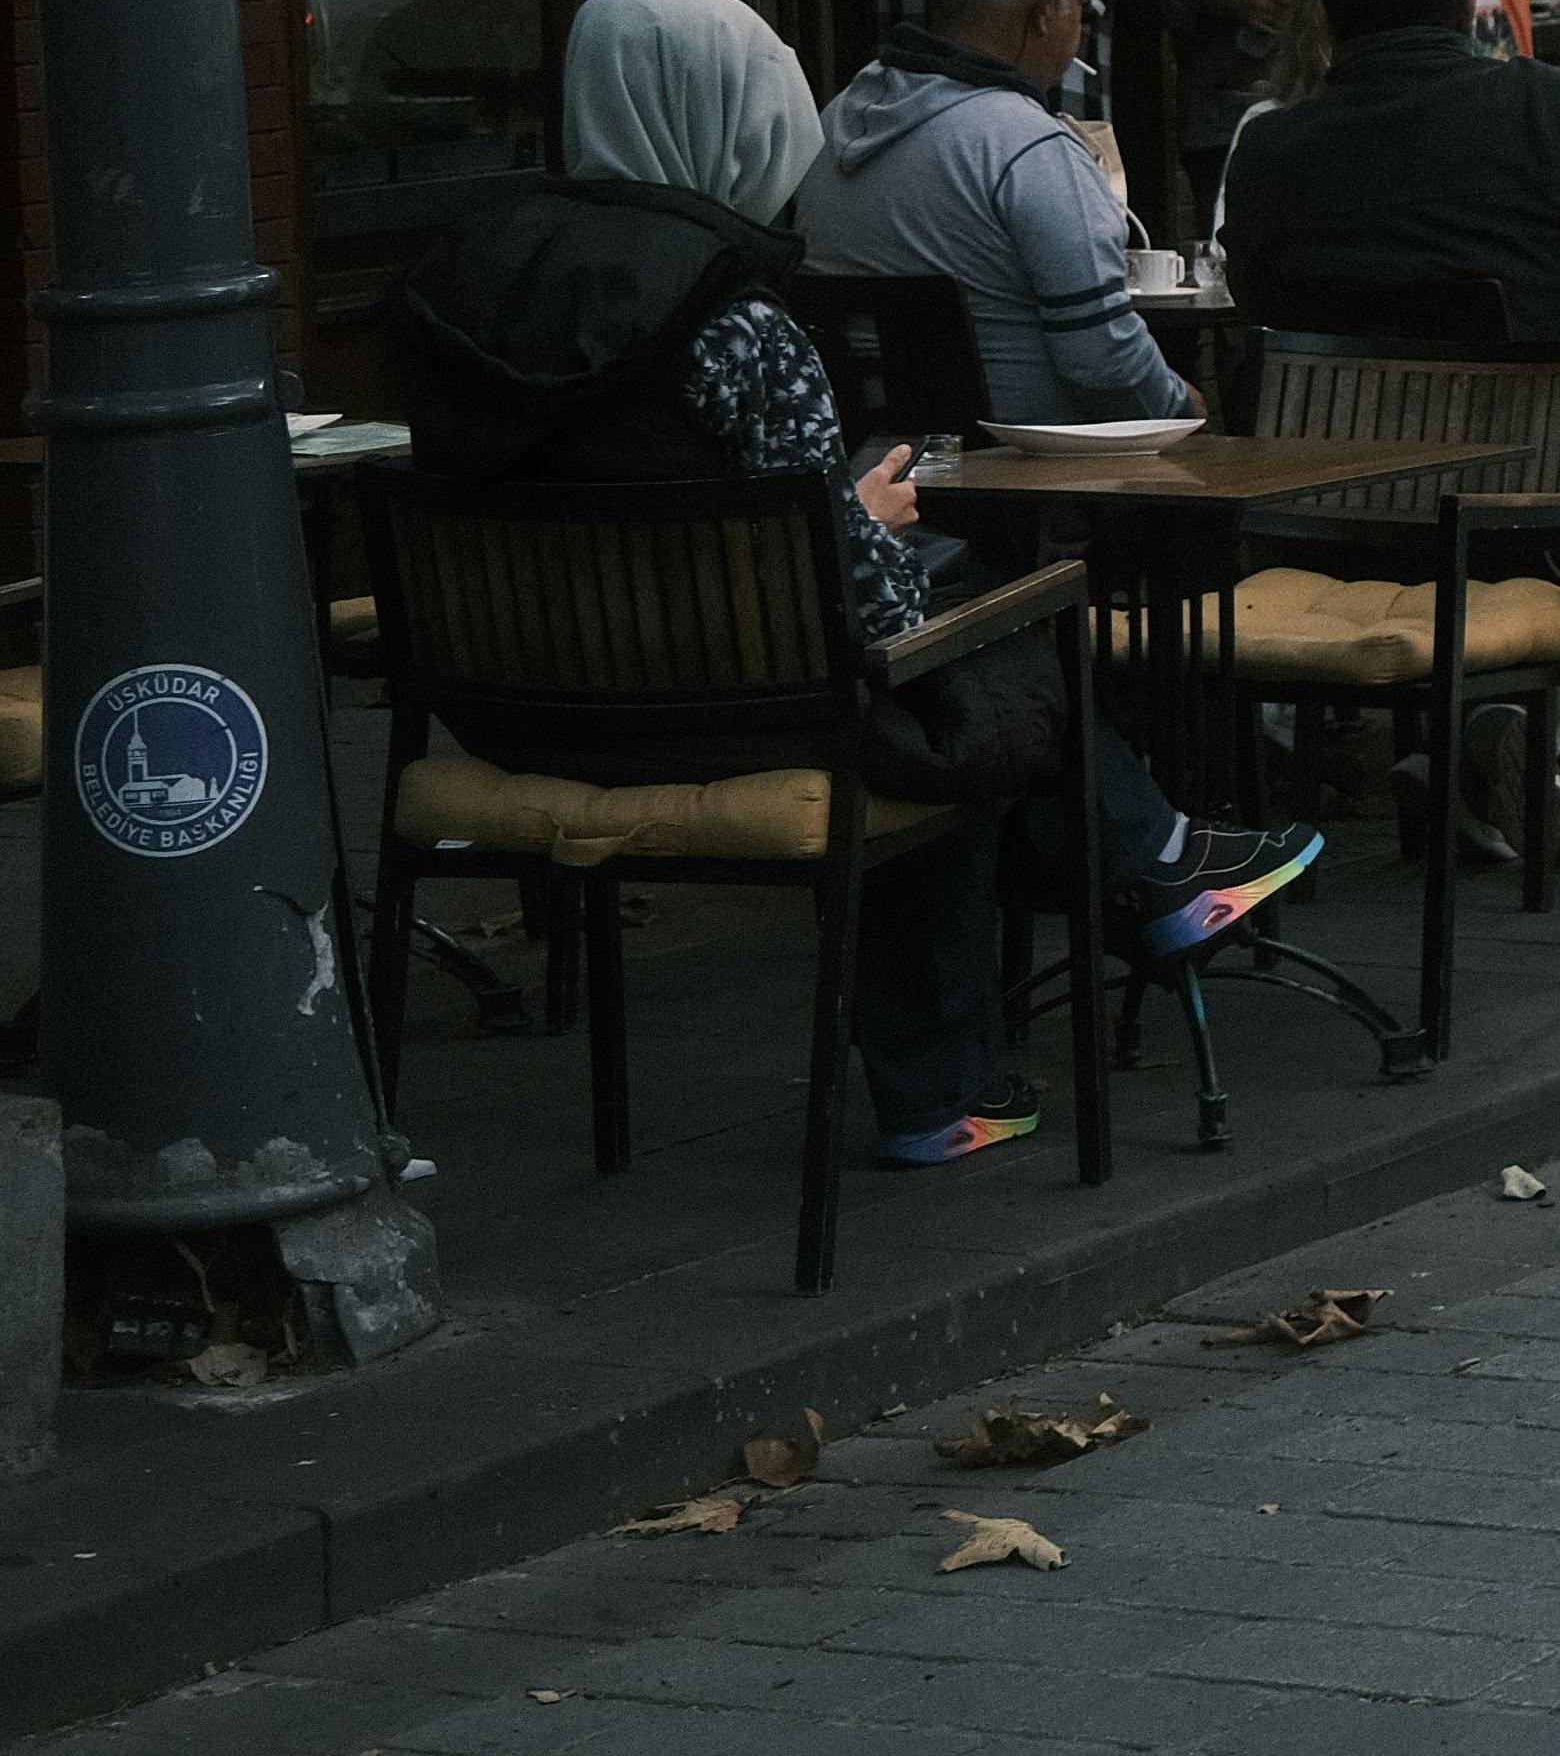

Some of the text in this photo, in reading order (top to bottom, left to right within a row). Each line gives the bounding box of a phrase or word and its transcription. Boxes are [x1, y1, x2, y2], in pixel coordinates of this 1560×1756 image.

[107, 673, 221, 712] ÜSKÜDAR
[83, 752, 259, 848] BELEDİYE BAŞKANLIĞI
